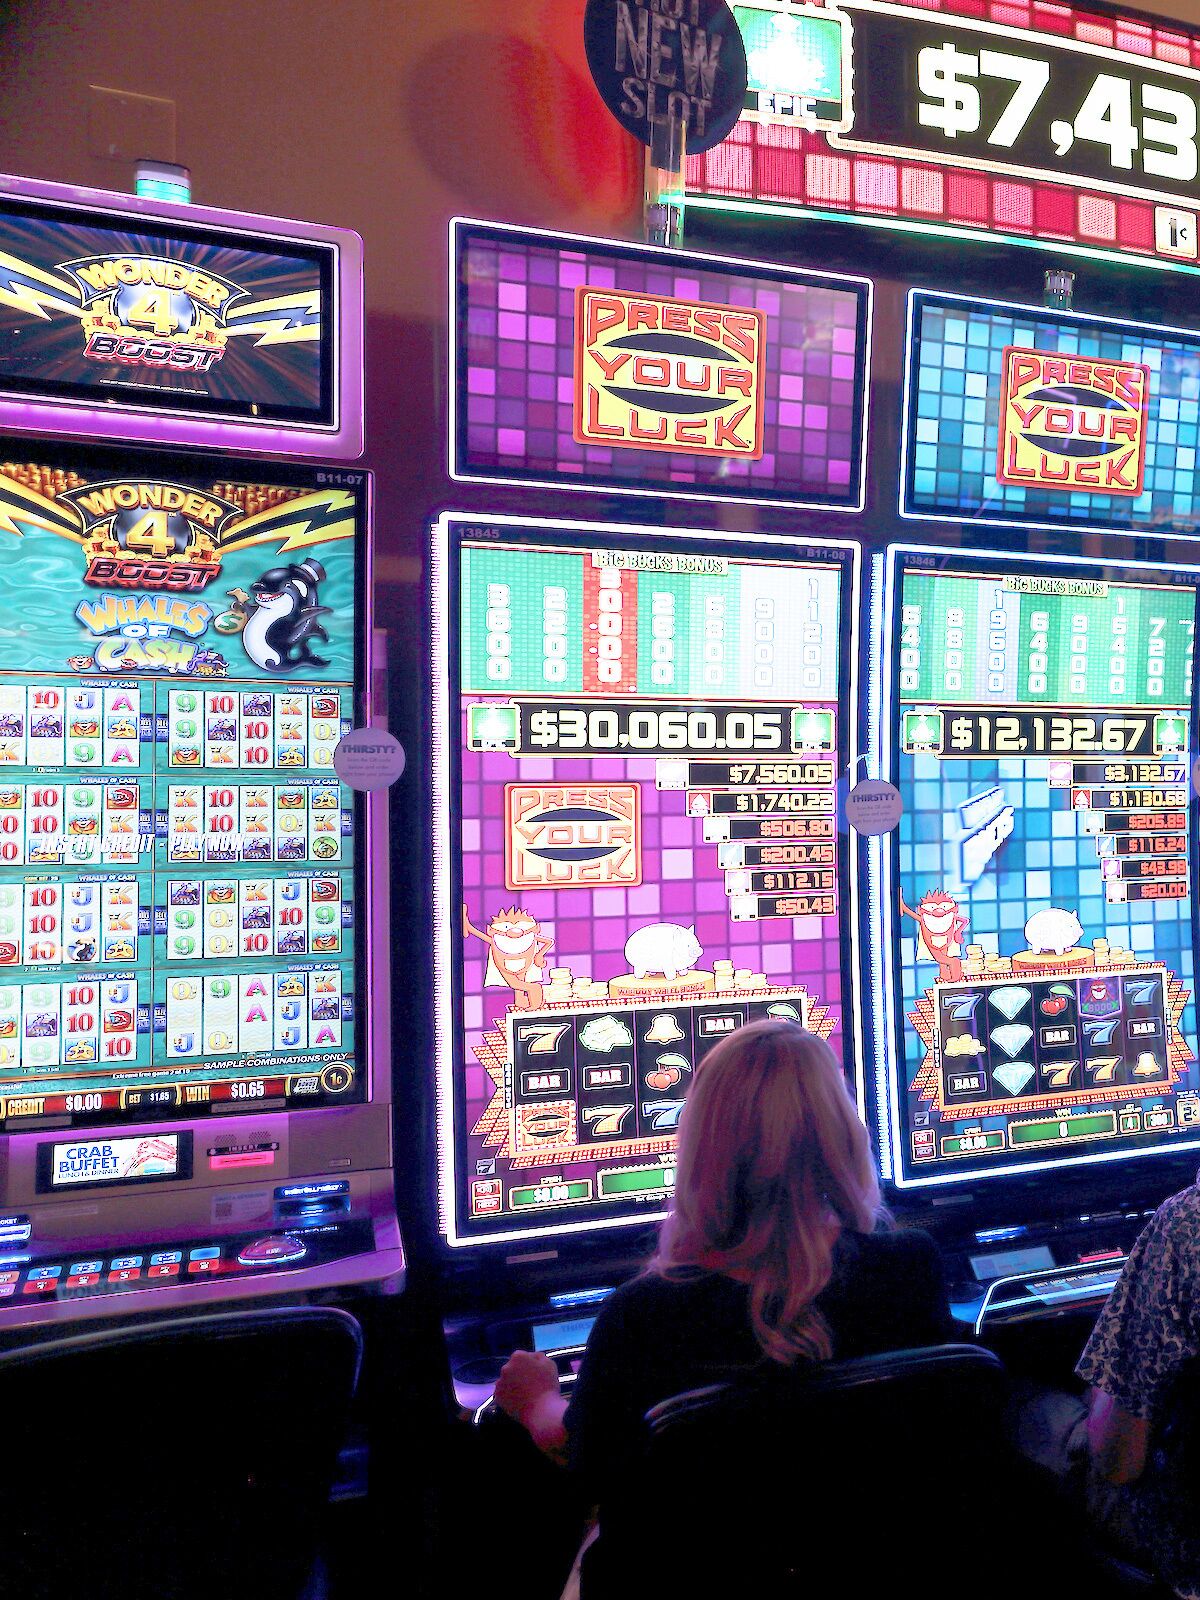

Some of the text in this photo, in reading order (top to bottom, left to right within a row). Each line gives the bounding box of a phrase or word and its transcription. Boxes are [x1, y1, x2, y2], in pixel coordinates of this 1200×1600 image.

[614, 1, 722, 100] NEW
[620, 77, 712, 136] SLOT
[757, 91, 818, 119] EPIC
[77, 258, 230, 308] WONDER
[128, 289, 180, 336] 4
[587, 295, 756, 363] PRESS
[84, 332, 226, 373] BOOST
[588, 350, 752, 397] YOUR
[1009, 356, 1142, 412] PRESS
[587, 383, 752, 448] LUCK
[1011, 402, 1137, 441] YOUR
[1008, 431, 1136, 487] LUCK
[317, 473, 364, 485] B11-07
[77, 484, 224, 527] WONDER
[127, 511, 176, 558] 4
[458, 528, 500, 539] 13845
[628, 553, 673, 570] BUCKS
[677, 556, 723, 573] BONUS
[807, 549, 846, 560] B11-08
[903, 555, 936, 566] 13846
[84, 557, 223, 590] BOOST
[1031, 578, 1066, 593] BUCKS
[1068, 581, 1104, 596] BONUS
[76, 593, 213, 637] WHALES
[122, 624, 169, 638] OF
[96, 635, 197, 673] CASH
[210, 695, 234, 714] 10
[245, 721, 269, 739] 10
[530, 709, 782, 750] $30,060.05
[950, 716, 1149, 753] $12,132.67
[245, 746, 269, 765] 10
[341, 744, 397, 754] THIRSTY?
[729, 764, 832, 784] $7,560.05
[1104, 764, 1185, 782] $3,132.67
[514, 789, 633, 823] PRESS
[736, 793, 832, 812] $1,740.22
[1109, 790, 1186, 807] $1,130.68
[760, 819, 832, 837] $506.80
[1128, 814, 1186, 830] $205.89
[39, 832, 246, 854] INSERT CREDIT PLAY NOW
[515, 825, 632, 845] YOUR
[1128, 836, 1186, 852] $116.24
[760, 845, 833, 863] $200.45
[516, 847, 632, 883] LUCK
[1140, 859, 1186, 875] $43.98
[763, 871, 833, 889] $112.15
[1141, 882, 1186, 898] $20.00
[775, 897, 834, 915] $50.43
[1123, 979, 1160, 1006] 7
[943, 992, 983, 1021] 7
[704, 1016, 735, 1033] BAR
[1083, 1018, 1120, 1047] 7
[1133, 1021, 1156, 1035] BAR
[518, 1023, 571, 1055] 7
[1046, 1029, 1069, 1043] BAR
[203, 1059, 245, 1070] SAMPLE
[246, 1055, 321, 1067] COMBINATIONS
[322, 1052, 348, 1062] ONLY
[1085, 1055, 1123, 1083] 7
[528, 1075, 561, 1090] BAR
[590, 1069, 622, 1085] BAR
[954, 1076, 980, 1090] BAR
[1041, 1060, 1080, 1088] 7
[128, 1094, 141, 1104] BET
[186, 1080, 265, 1102] WIN $0.65
[7, 1093, 103, 1116] CREDIT $0.00
[583, 1105, 634, 1137] 7
[66, 1145, 113, 1160] CRAB
[59, 1156, 119, 1172] BUFFET
[91, 1168, 119, 1176] DINNER
